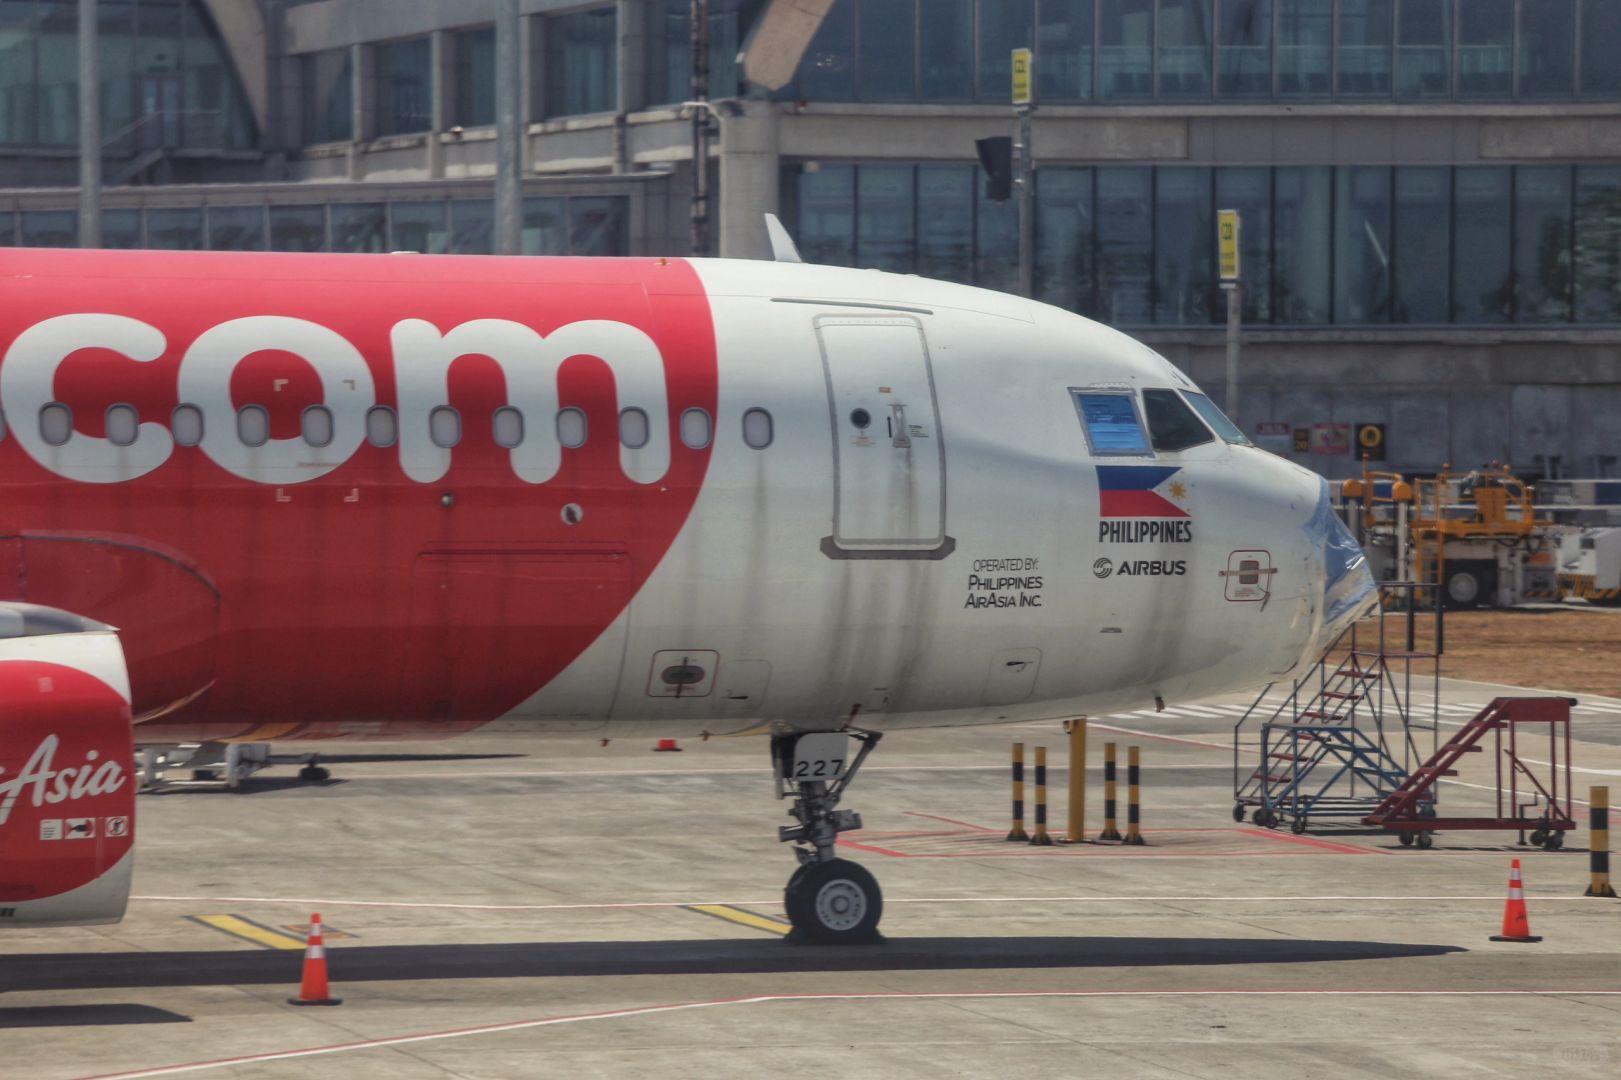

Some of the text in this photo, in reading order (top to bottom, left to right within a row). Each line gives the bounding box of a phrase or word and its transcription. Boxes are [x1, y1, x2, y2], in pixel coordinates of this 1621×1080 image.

[1099, 520, 1192, 543] PHILIPPINES
[973, 557, 1039, 572] OPERATED BY:
[1117, 560, 1187, 576] AIRBUS
[968, 574, 1043, 590] PHILIPPINES
[796, 760, 843, 777] 227
